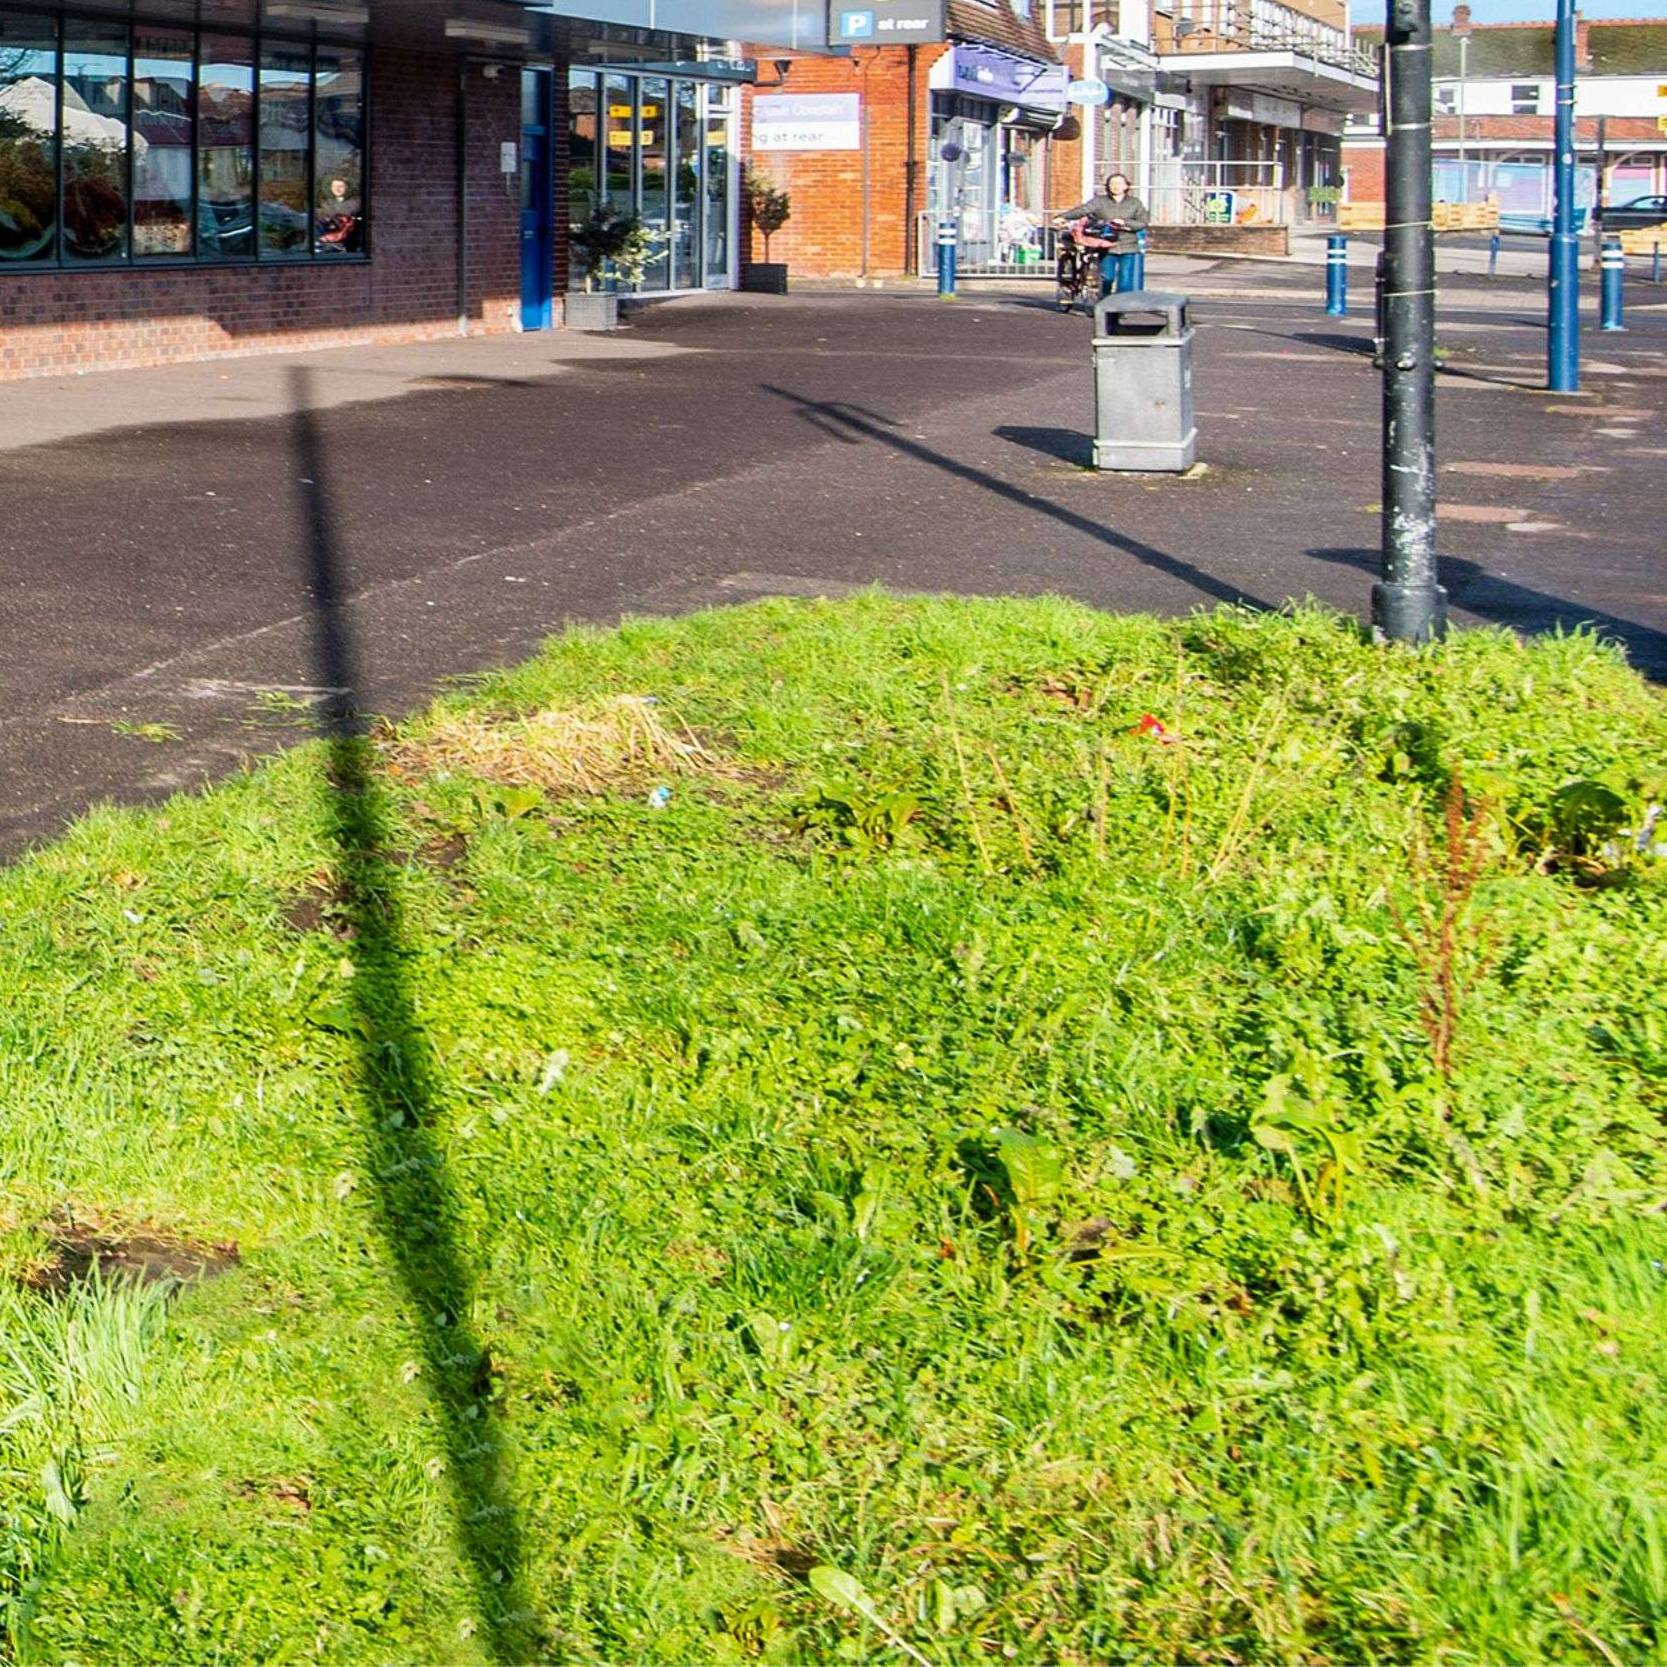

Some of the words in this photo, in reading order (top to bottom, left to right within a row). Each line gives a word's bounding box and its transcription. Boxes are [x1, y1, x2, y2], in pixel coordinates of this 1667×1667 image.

[848, 13, 867, 35] P
[877, 18, 894, 31] at
[896, 18, 929, 30] rear
